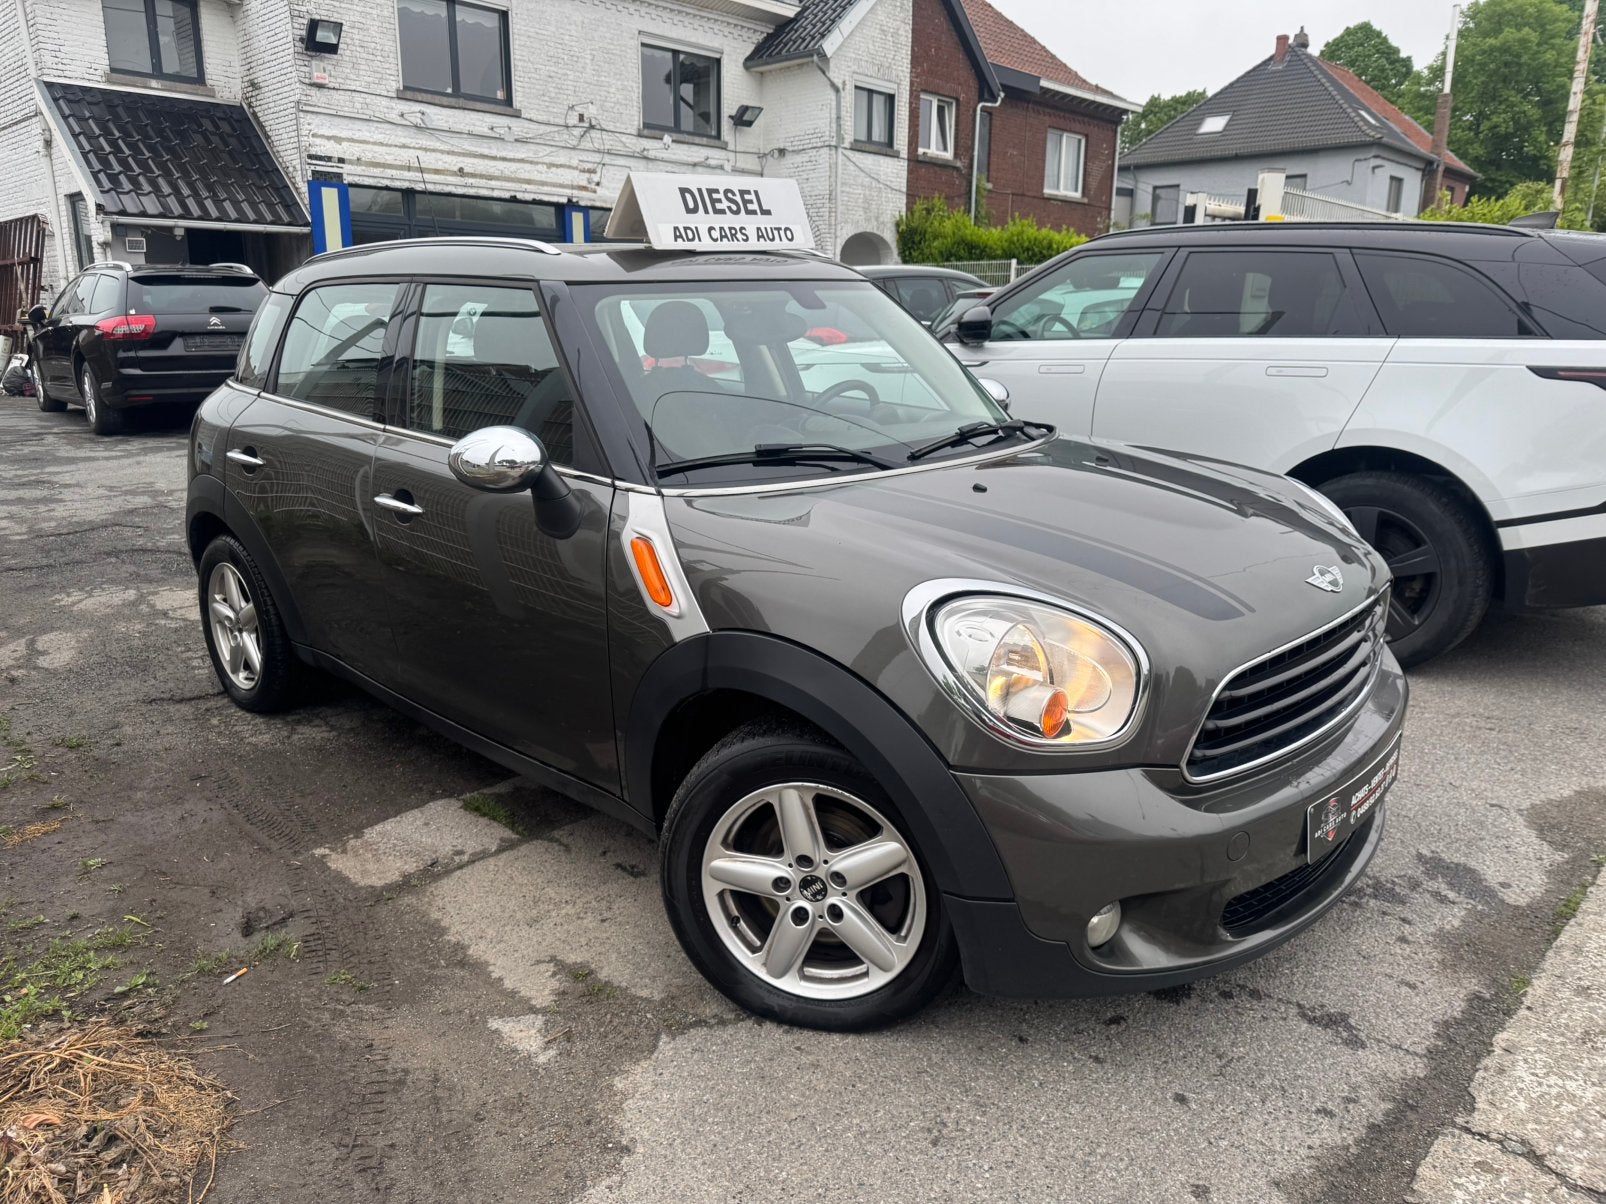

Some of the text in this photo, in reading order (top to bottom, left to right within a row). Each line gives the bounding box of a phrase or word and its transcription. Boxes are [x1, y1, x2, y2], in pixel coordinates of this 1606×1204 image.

[678, 187, 773, 216] DIESEL
[673, 226, 795, 243] ADI CARS AUTO
[804, 881, 823, 895] MINI
